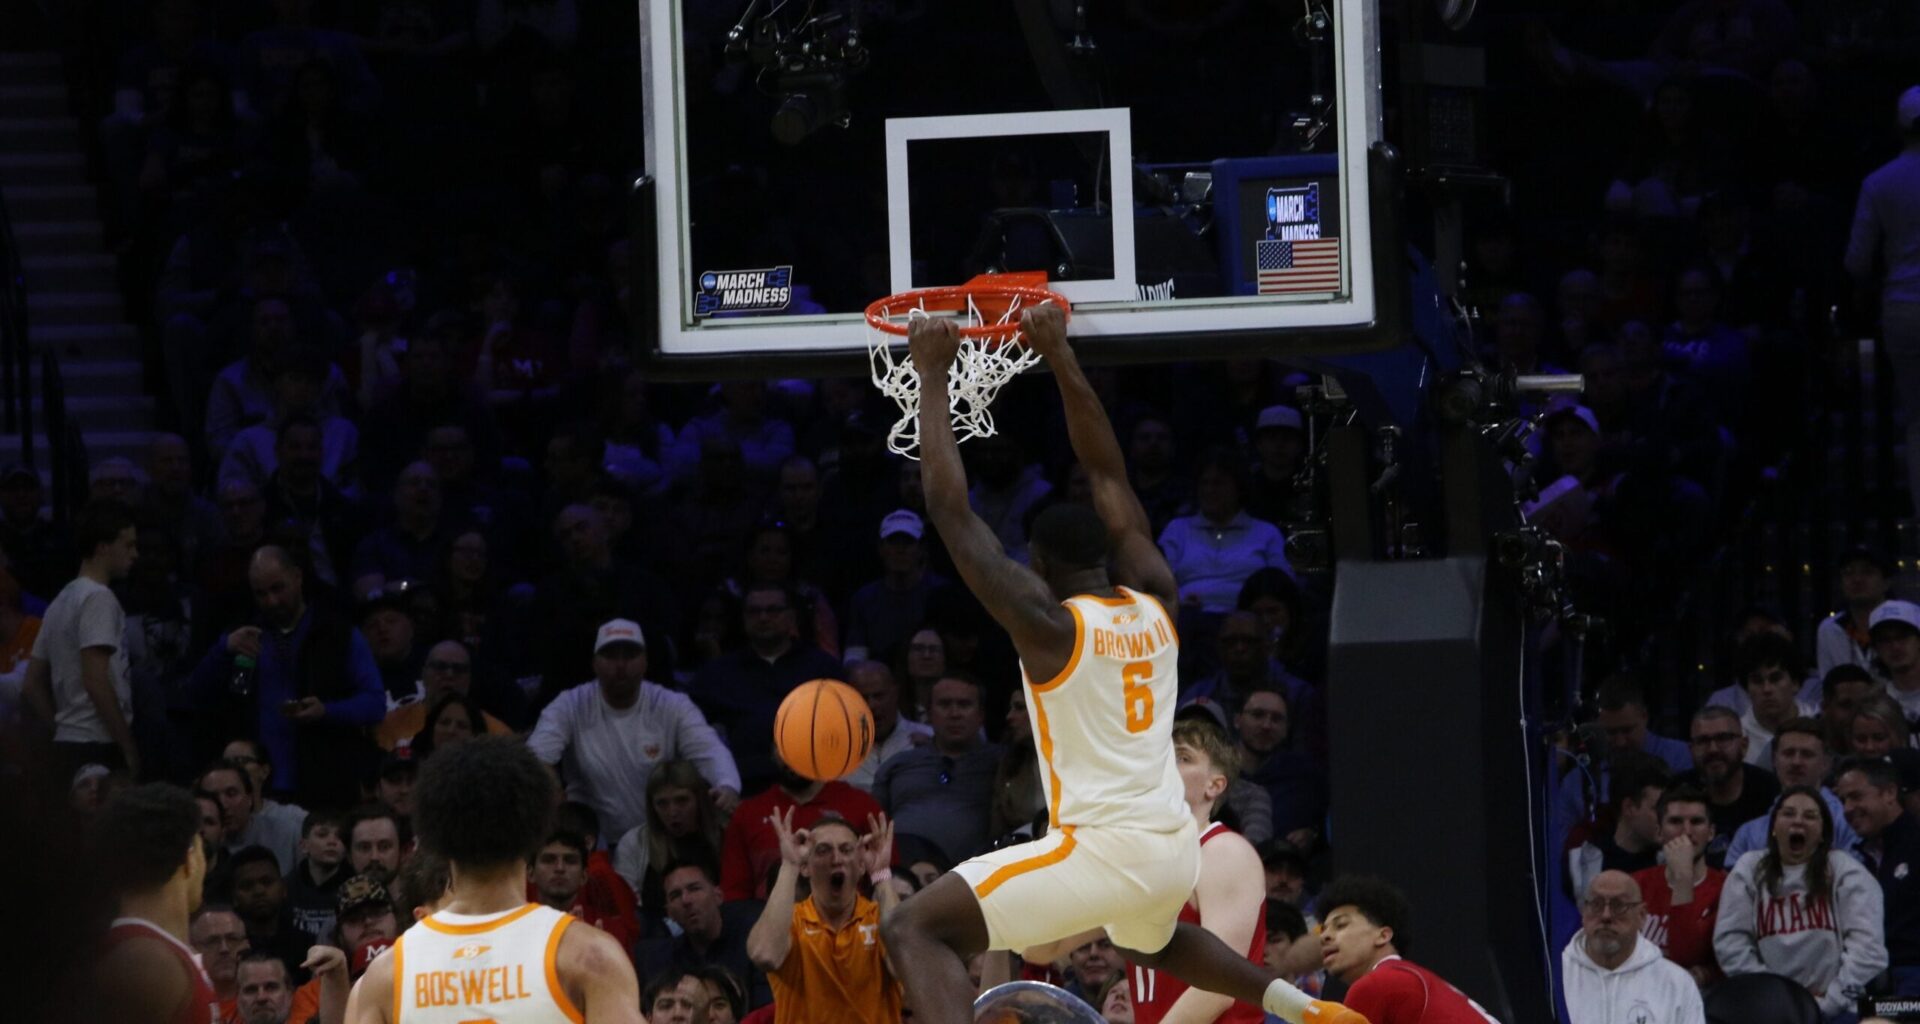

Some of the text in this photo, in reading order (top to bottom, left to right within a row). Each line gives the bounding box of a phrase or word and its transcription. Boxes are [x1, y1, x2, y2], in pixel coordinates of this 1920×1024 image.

[1276, 195, 1304, 223] MARCH
[716, 272, 766, 290] MARCH
[722, 286, 789, 305] MADNESS
[1094, 618, 1170, 659] BROWN II
[1121, 660, 1155, 735] 6
[414, 963, 532, 1009] BOSWELL
[1874, 1000, 1920, 1013] BODYARM
